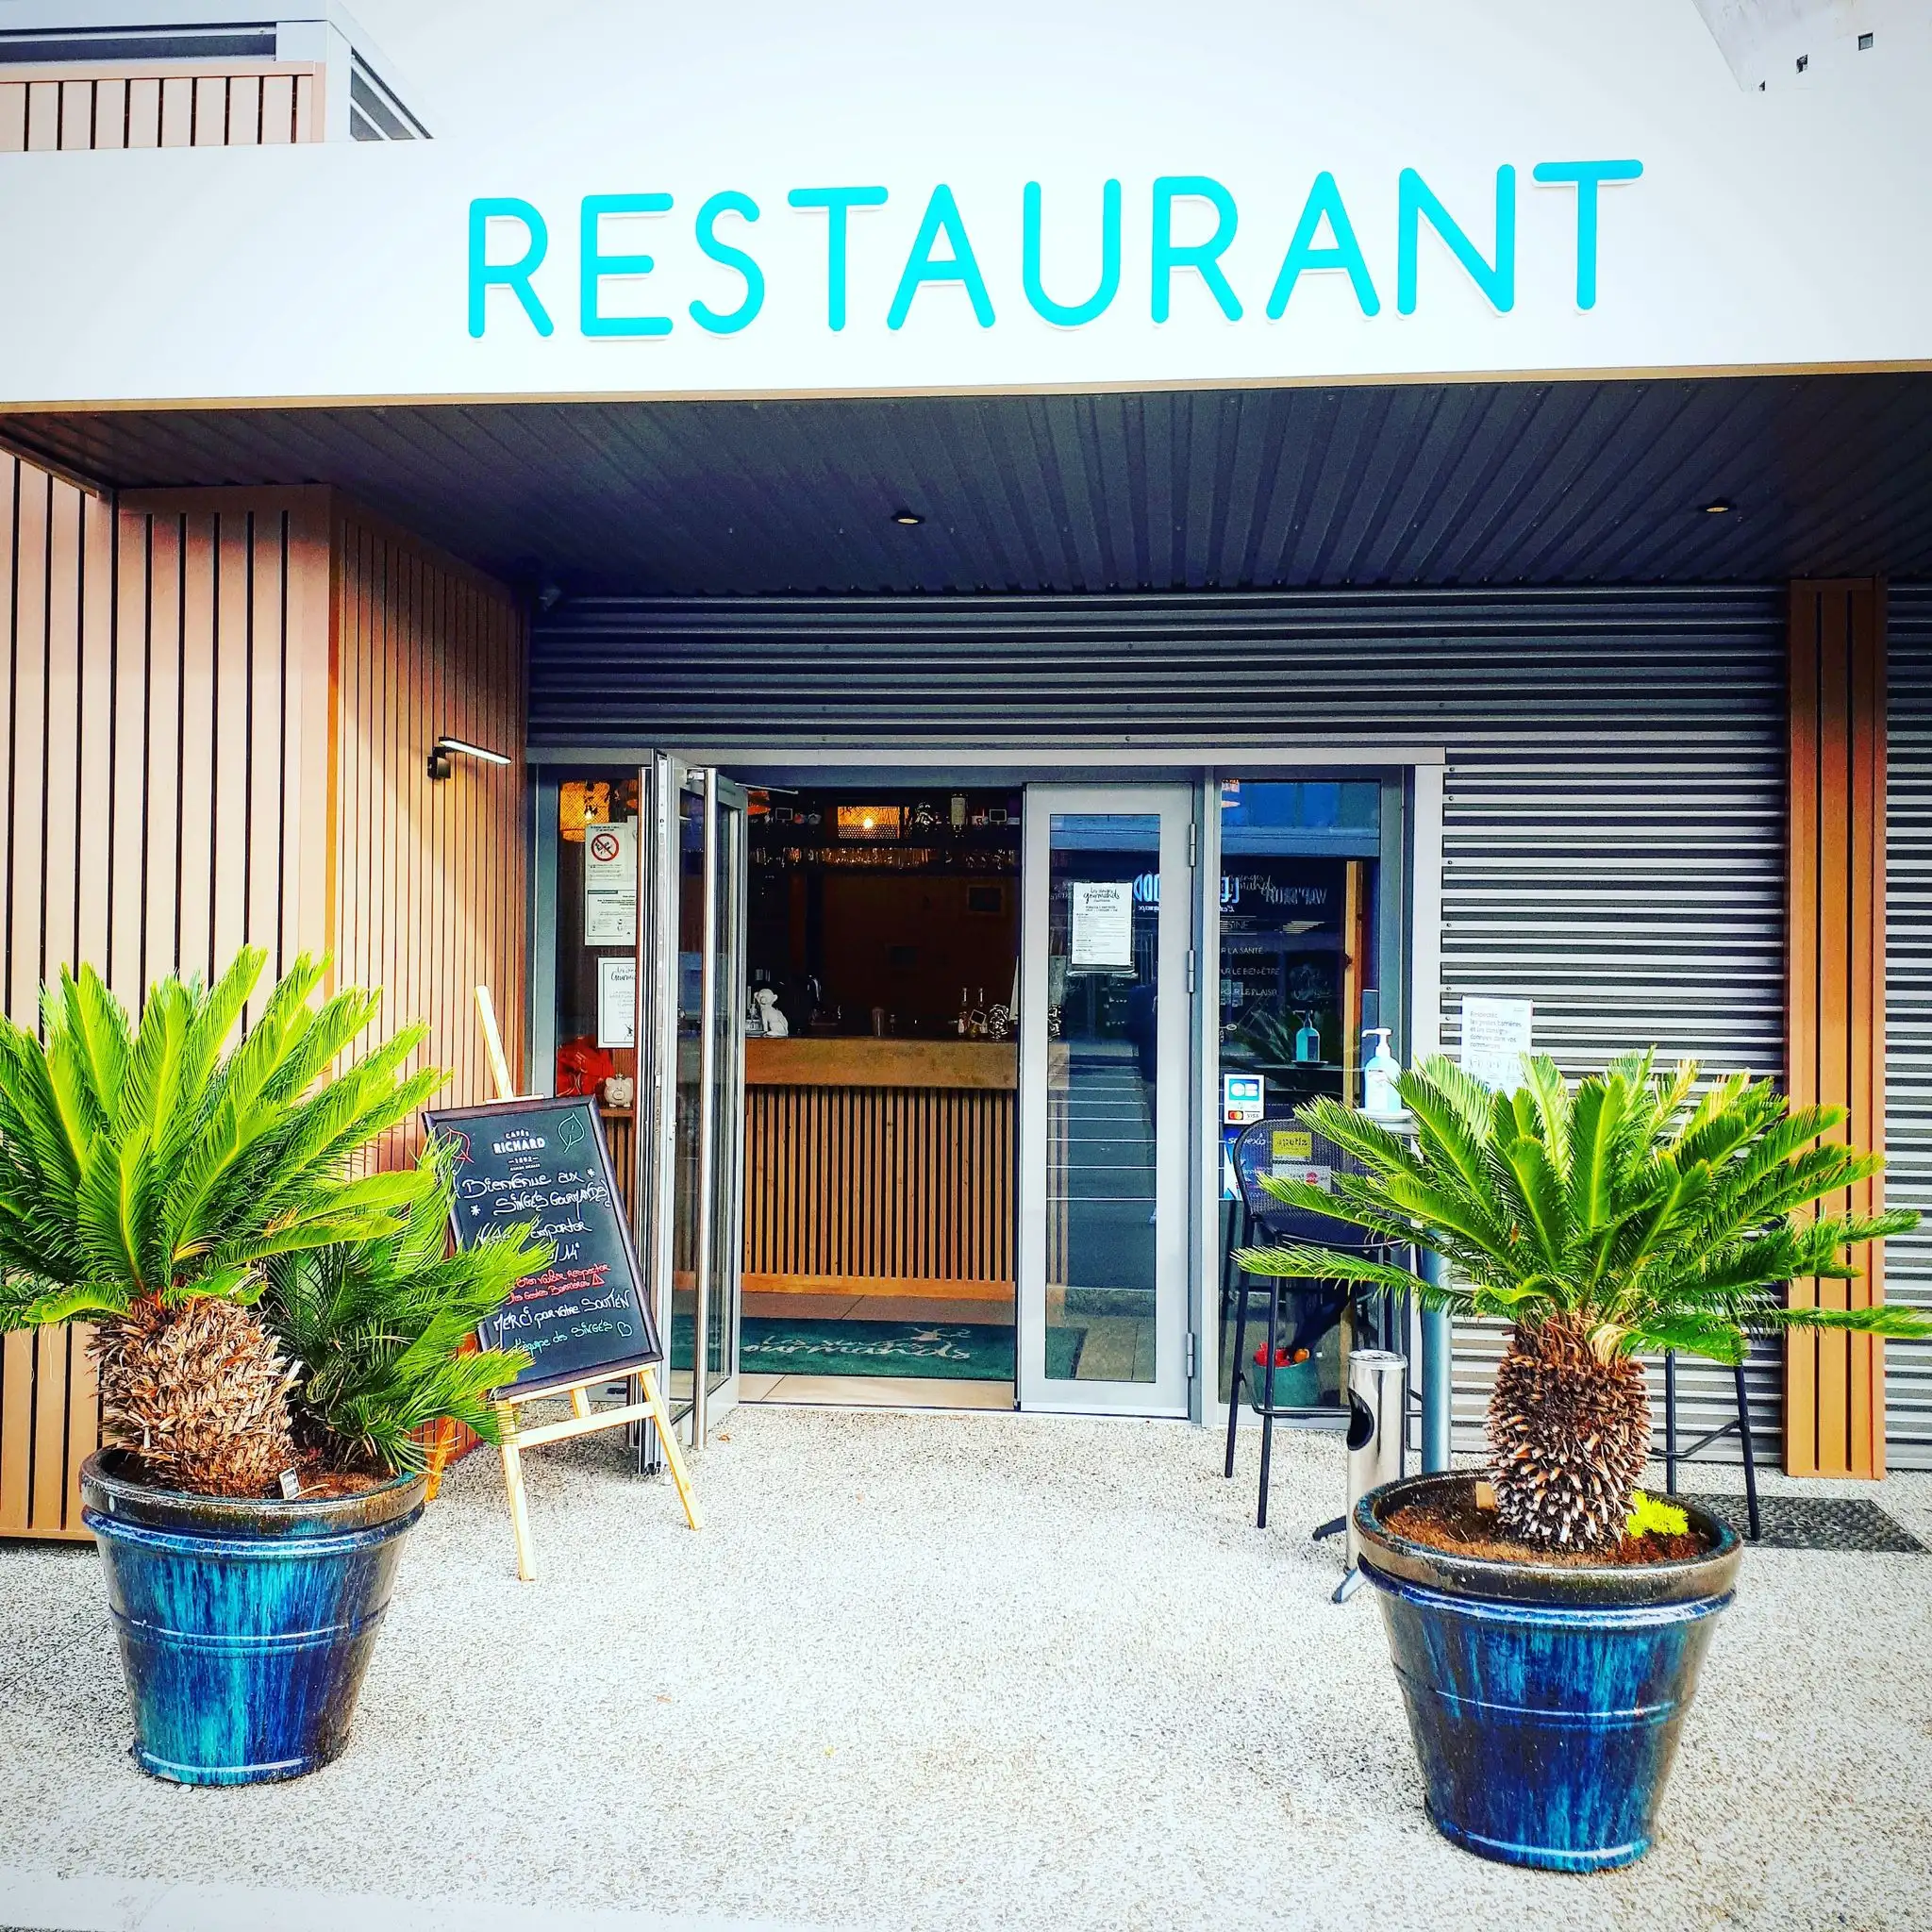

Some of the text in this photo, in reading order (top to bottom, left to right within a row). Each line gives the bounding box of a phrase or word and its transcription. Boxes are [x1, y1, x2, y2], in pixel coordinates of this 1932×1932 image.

[467, 158, 1644, 339] RESTAURANT
[492, 1138, 546, 1154] RICHARD
[462, 1171, 585, 1199] Bienvenue aux
